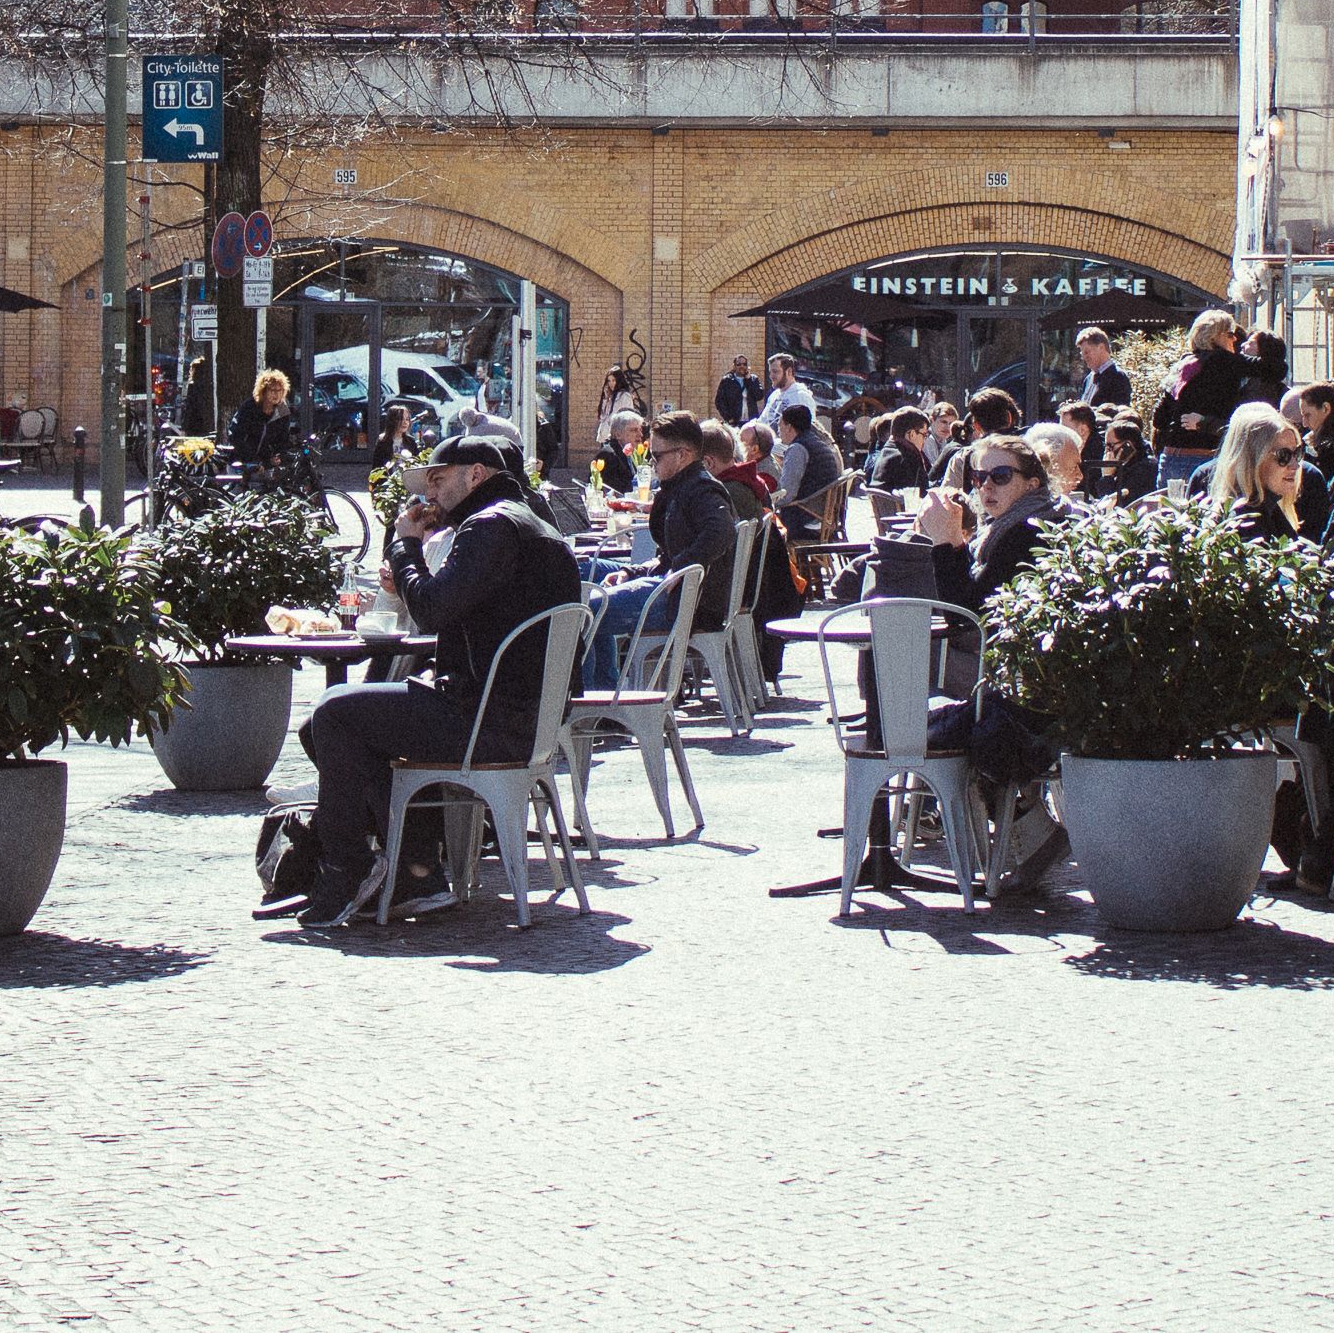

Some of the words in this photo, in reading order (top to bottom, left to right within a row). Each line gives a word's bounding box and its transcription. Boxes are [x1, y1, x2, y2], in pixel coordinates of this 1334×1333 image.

[147, 61, 220, 77] City-Toilette
[337, 170, 355, 183] 595
[988, 173, 1007, 185] 596
[853, 277, 988, 295] EINSTEIN
[1031, 278, 1147, 296] KAFFEE
